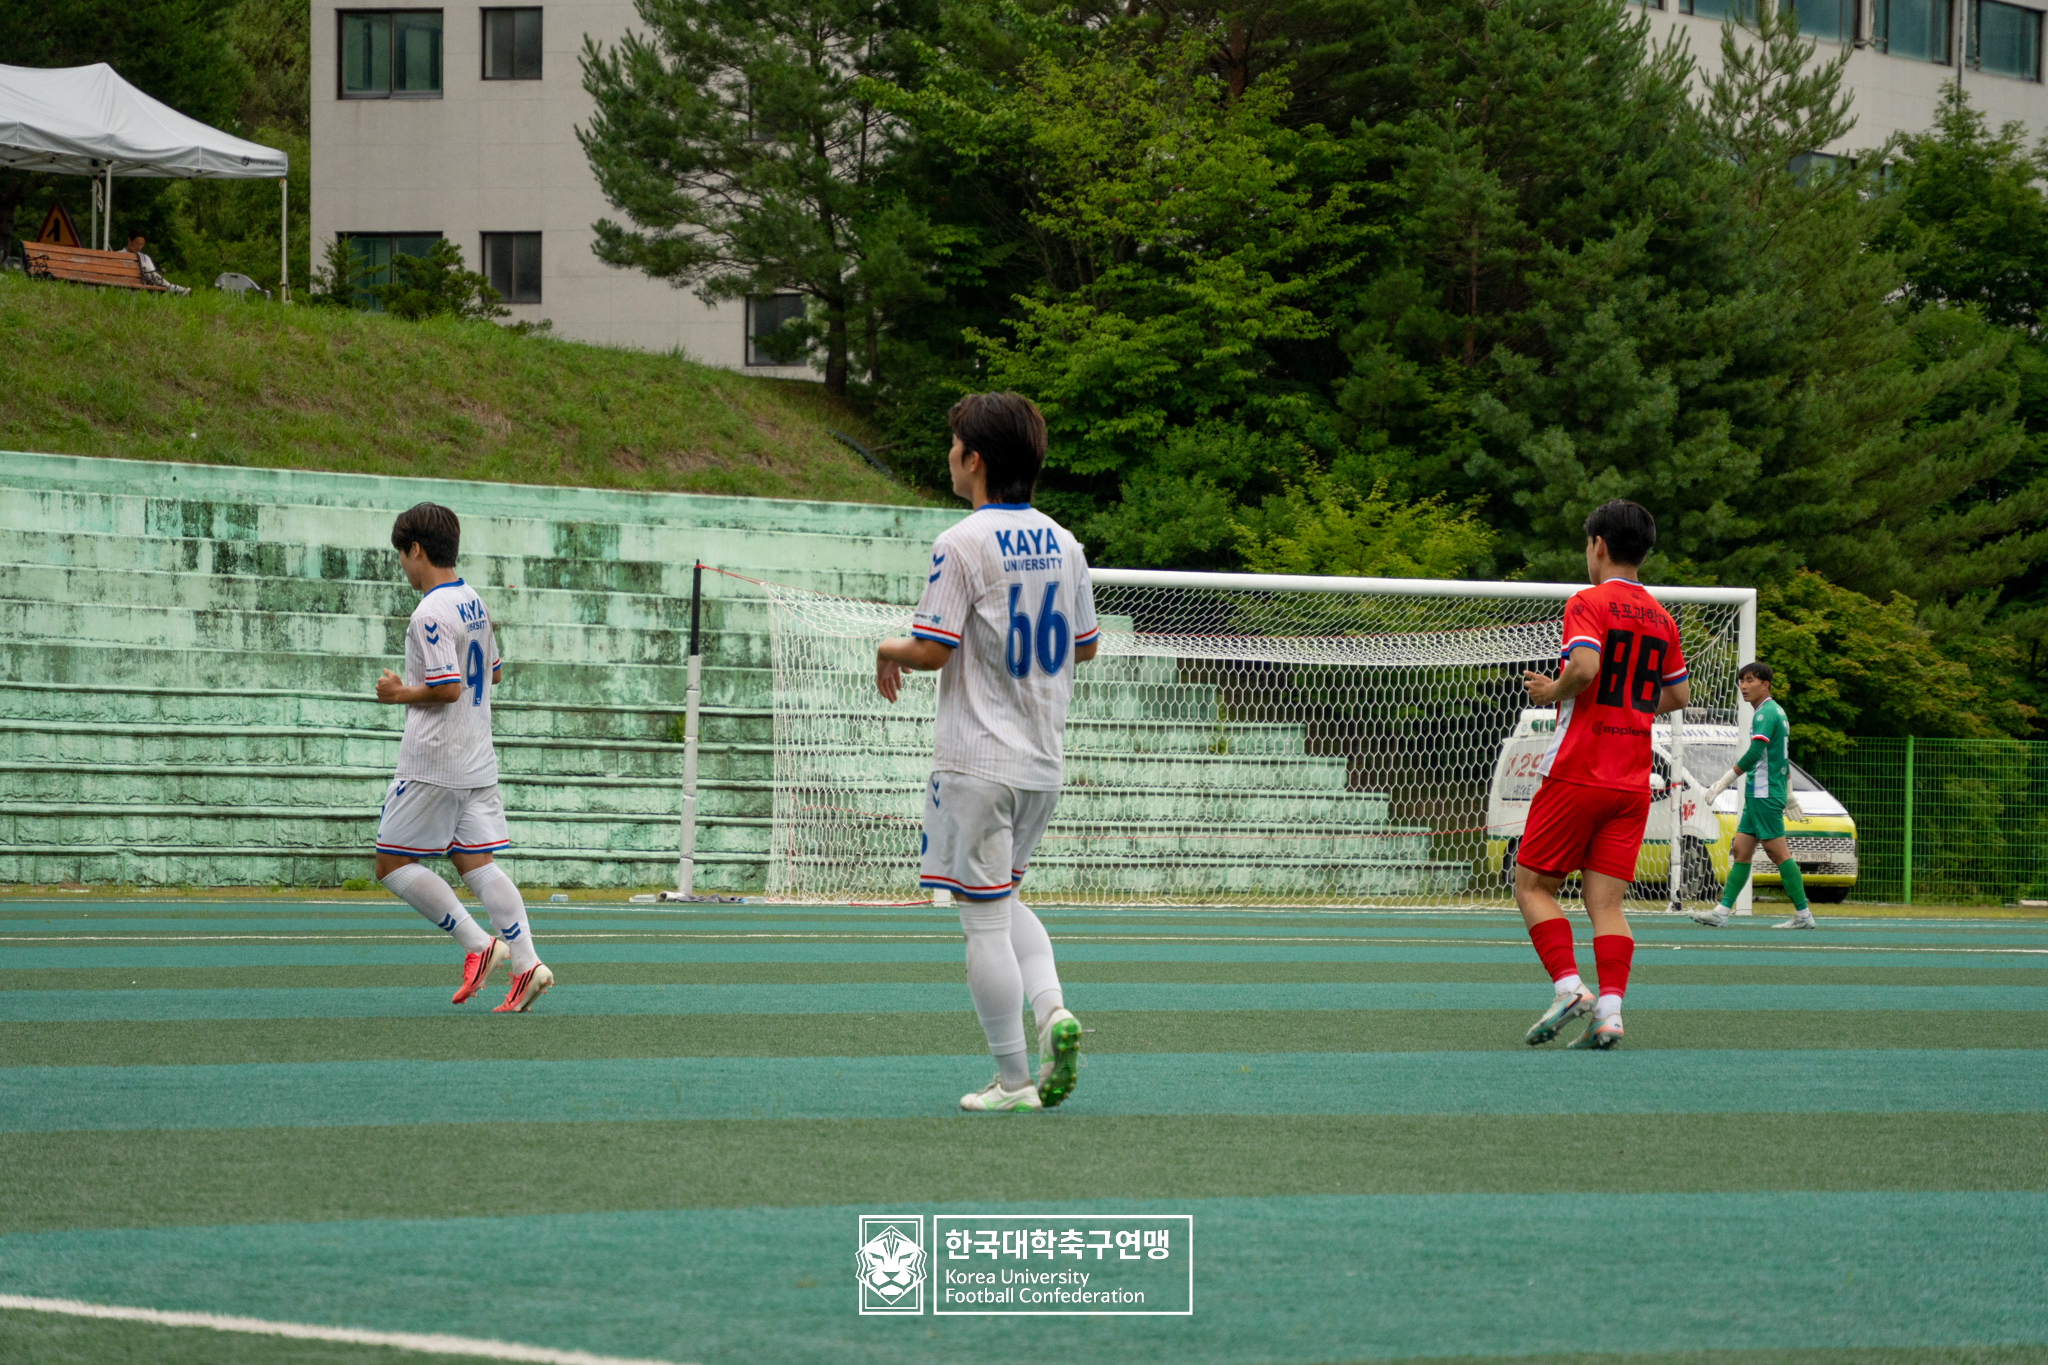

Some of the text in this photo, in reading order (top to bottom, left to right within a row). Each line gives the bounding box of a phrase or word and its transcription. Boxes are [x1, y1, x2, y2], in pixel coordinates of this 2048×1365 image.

[995, 528, 1061, 557] KAYA
[1003, 557, 1063, 572] UNIVERSITY
[1005, 581, 1070, 679] 66
[466, 639, 484, 708] 9
[1595, 628, 1669, 714] 88
